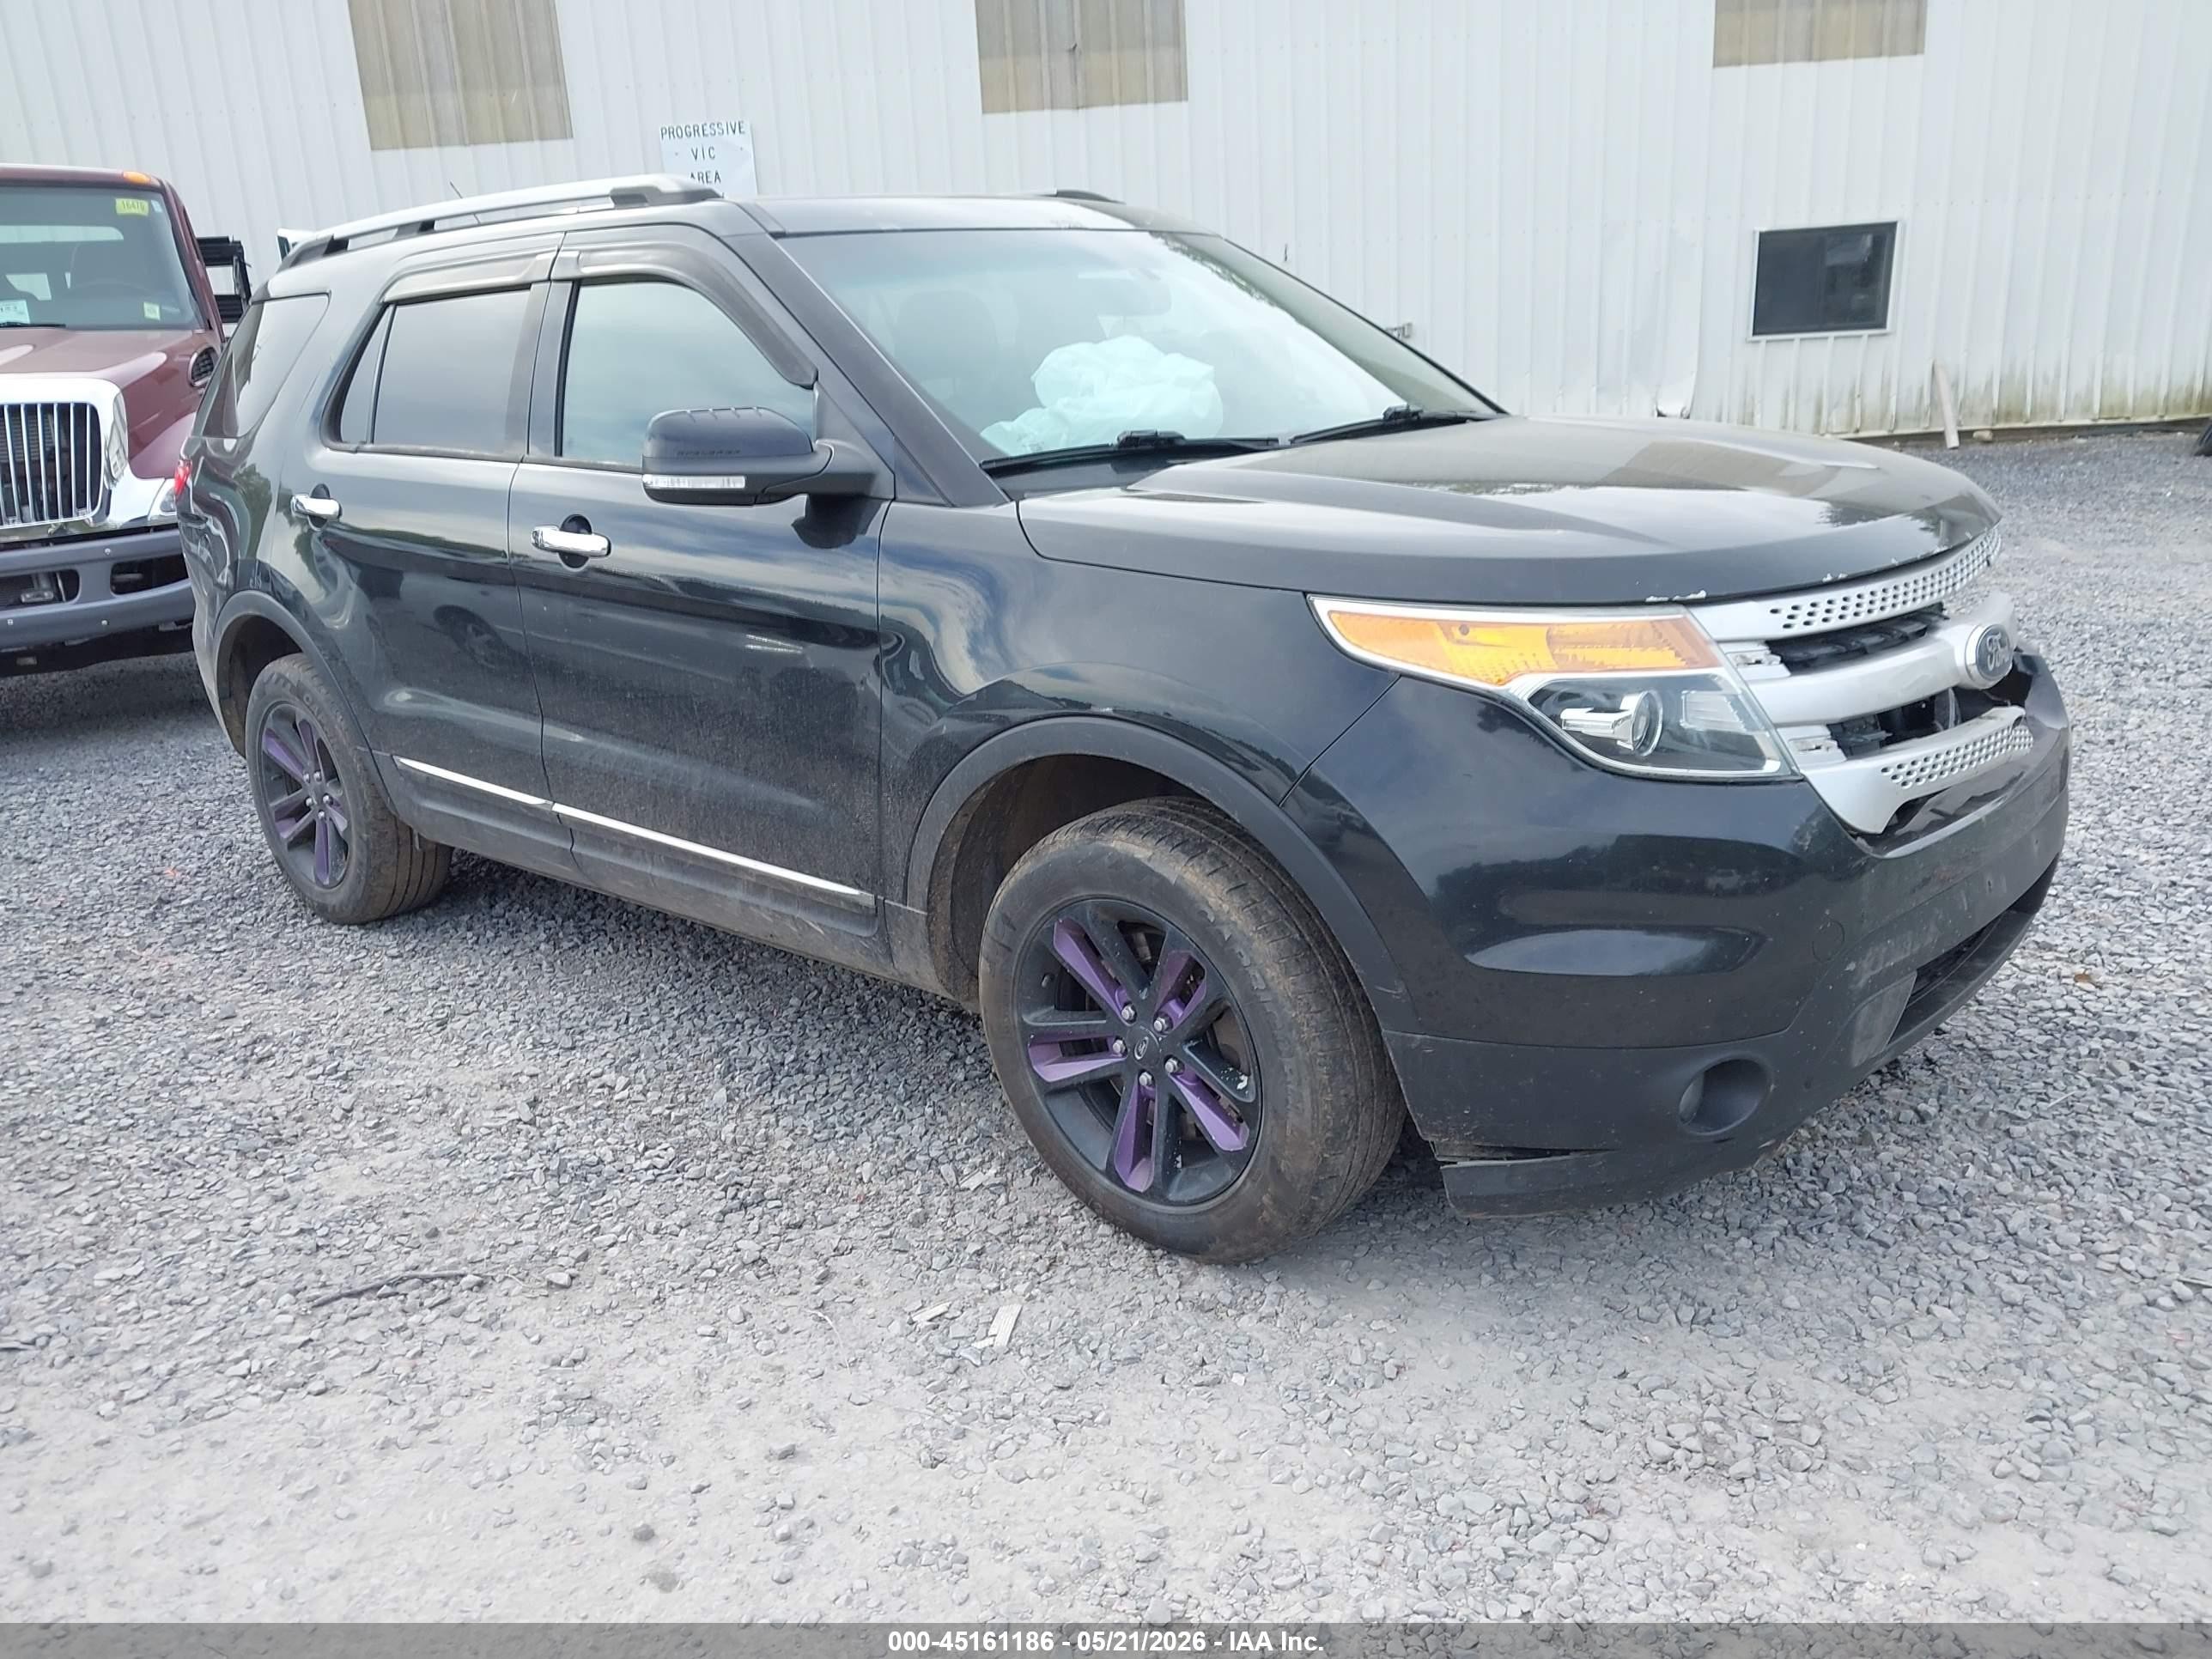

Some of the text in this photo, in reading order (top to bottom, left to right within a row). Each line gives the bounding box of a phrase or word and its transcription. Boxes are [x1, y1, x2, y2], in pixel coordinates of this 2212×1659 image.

[659, 120, 745, 140] PROGRESSIVE
[691, 144, 716, 161] VIC
[1986, 632, 2011, 671] Ford
